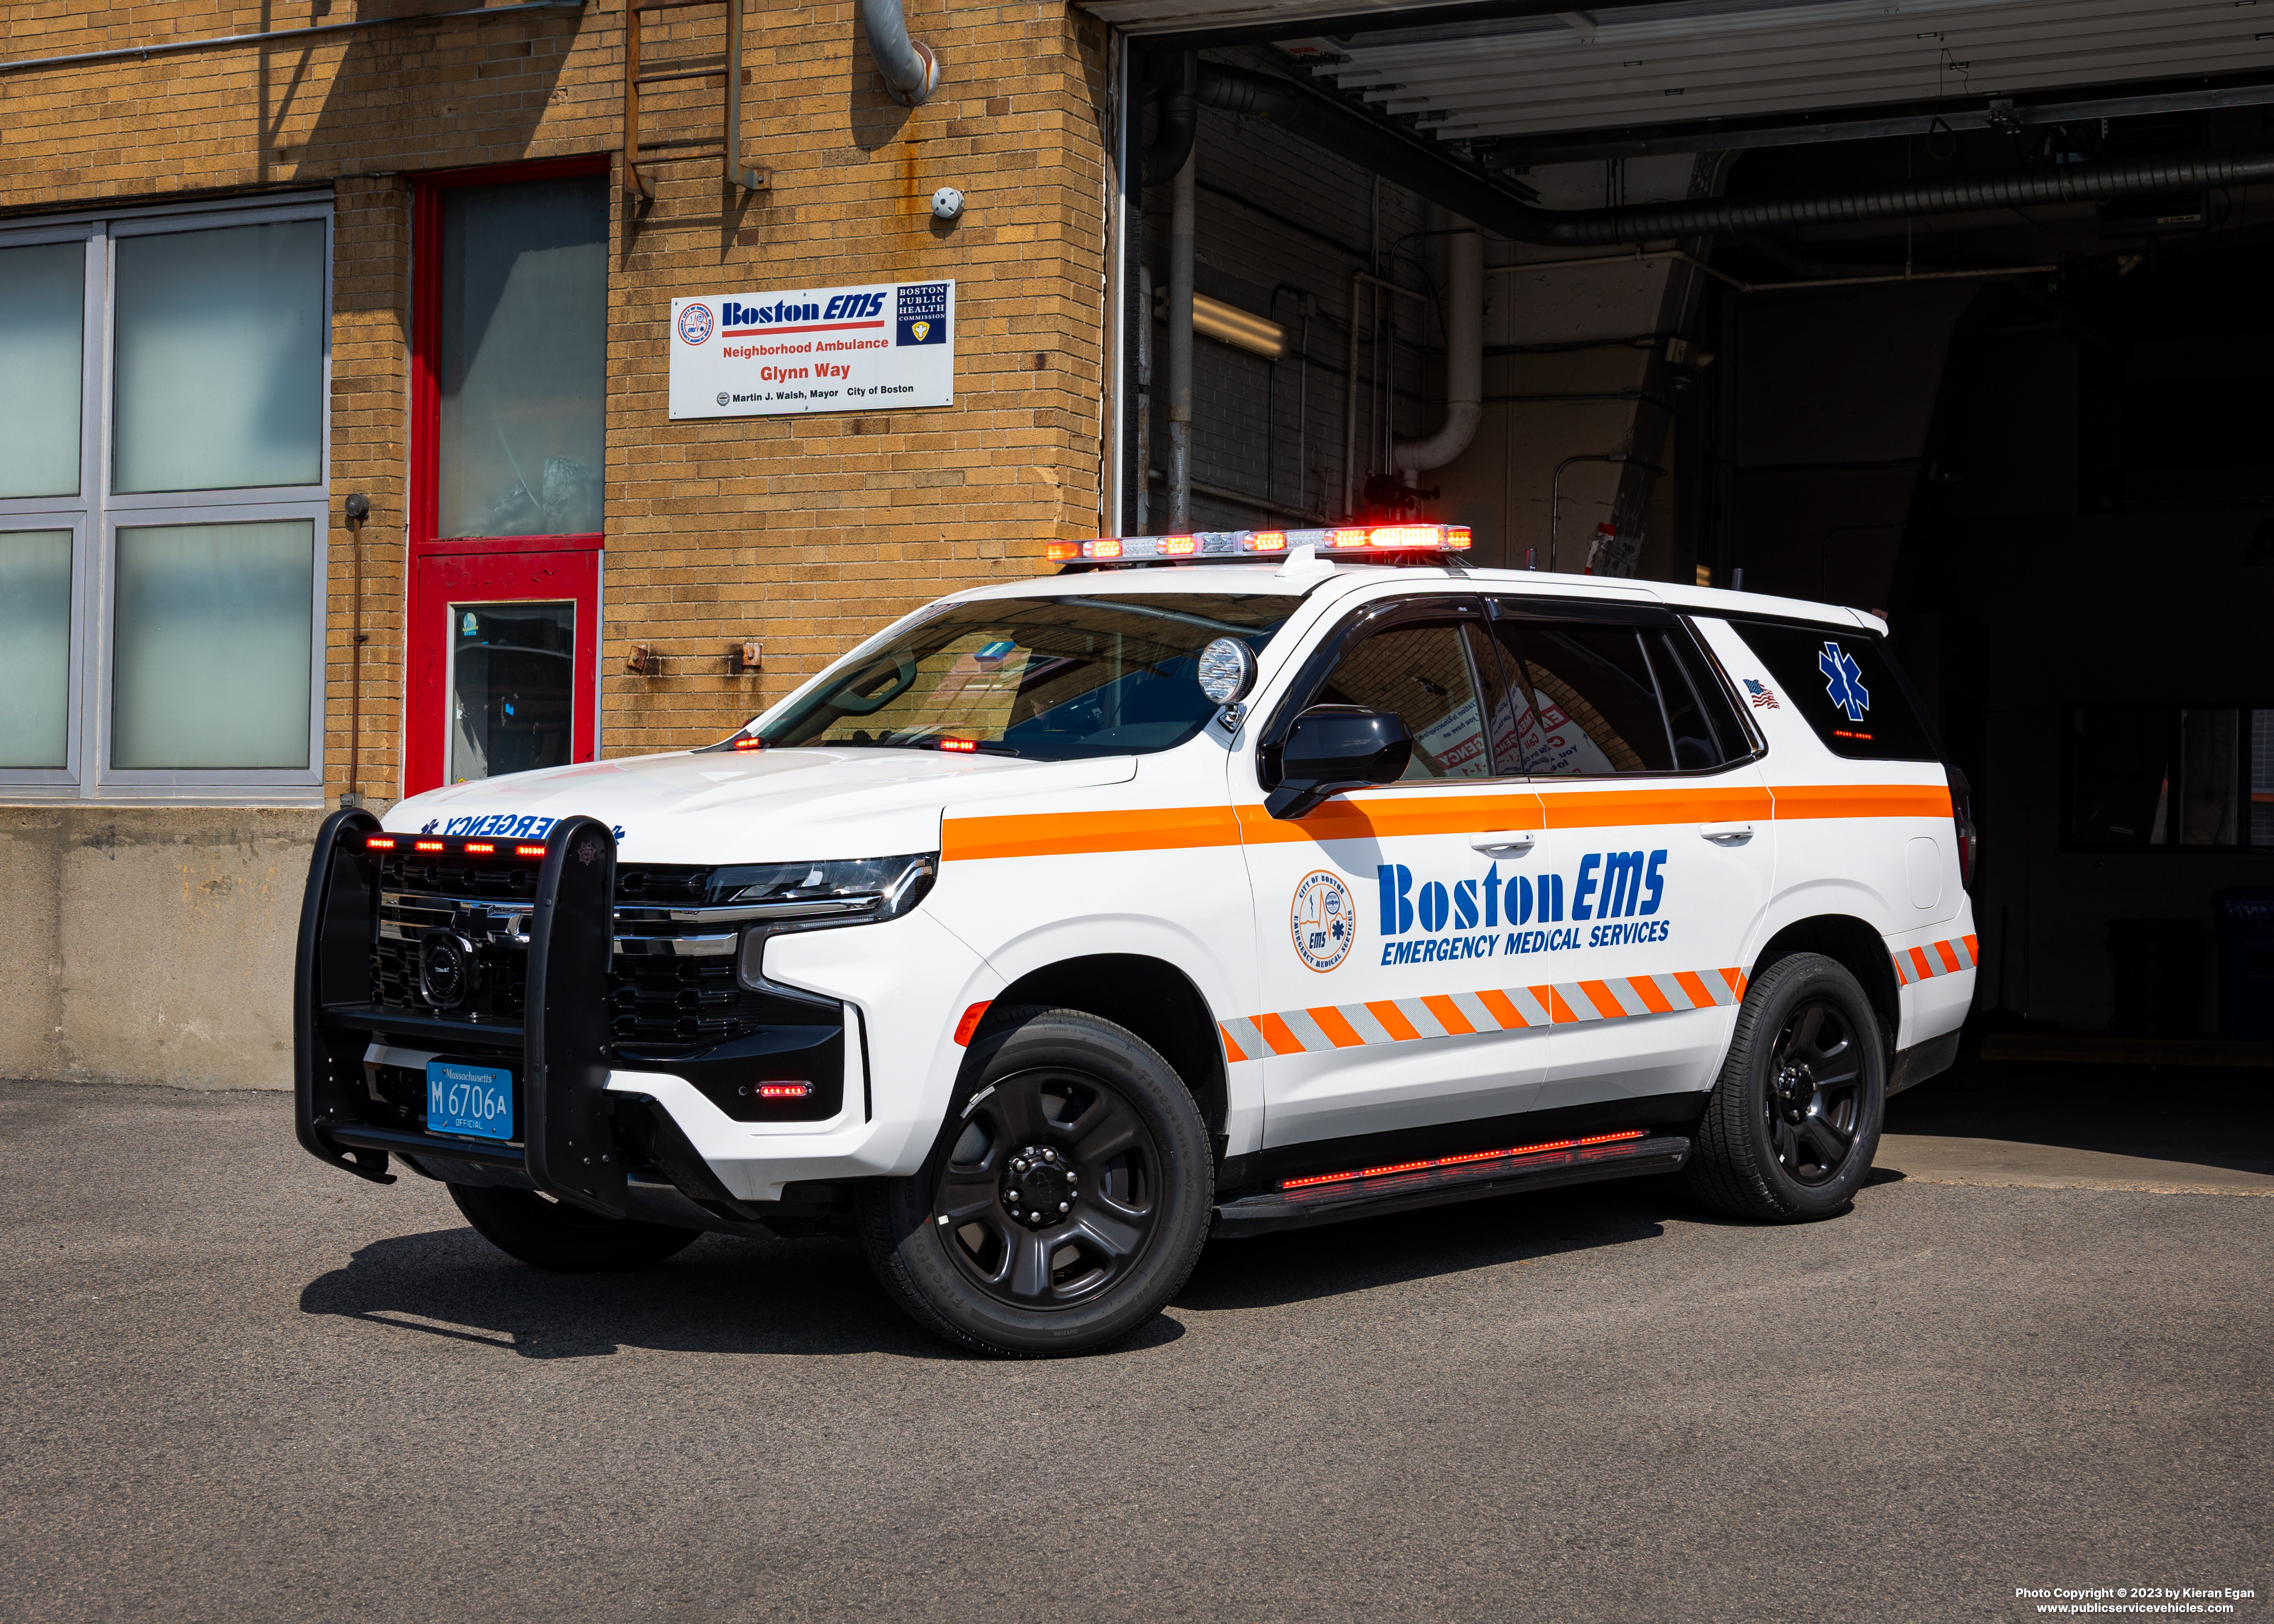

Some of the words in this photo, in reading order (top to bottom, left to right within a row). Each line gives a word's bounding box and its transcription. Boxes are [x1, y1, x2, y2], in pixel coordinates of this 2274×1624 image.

[899, 287, 945, 295] BOSTON
[899, 296, 944, 304] PUBLIC
[723, 299, 819, 326] Boston
[823, 292, 887, 320] EMS
[899, 305, 945, 314] HEALTH
[723, 342, 812, 359] Neighborhood
[816, 339, 888, 352] Ambulance
[761, 365, 808, 383] Glynn
[815, 363, 851, 380] Way
[733, 393, 762, 403] Martin
[776, 391, 807, 400] Walsh,
[810, 389, 839, 400] Mayor
[847, 387, 865, 397] City
[868, 387, 878, 395] of
[881, 385, 913, 394] Boston
[1299, 881, 1310, 898] CITY
[1321, 875, 1344, 895] BOSTON
[1377, 860, 1563, 935] Boston
[1572, 849, 1668, 921] EMS
[1294, 916, 1314, 963] EMERGENCY
[1316, 953, 1341, 967] MEDICAL
[1341, 910, 1352, 952] SERVICES
[1309, 932, 1326, 949] EMS
[1381, 934, 1500, 965] EMERGENCY
[1504, 929, 1581, 955] MEDICAL
[1589, 920, 1670, 947] SERVICES
[446, 1068, 492, 1083] Massachusetts
[432, 1081, 443, 1114] M
[456, 1119, 483, 1129] OFFICIAL
